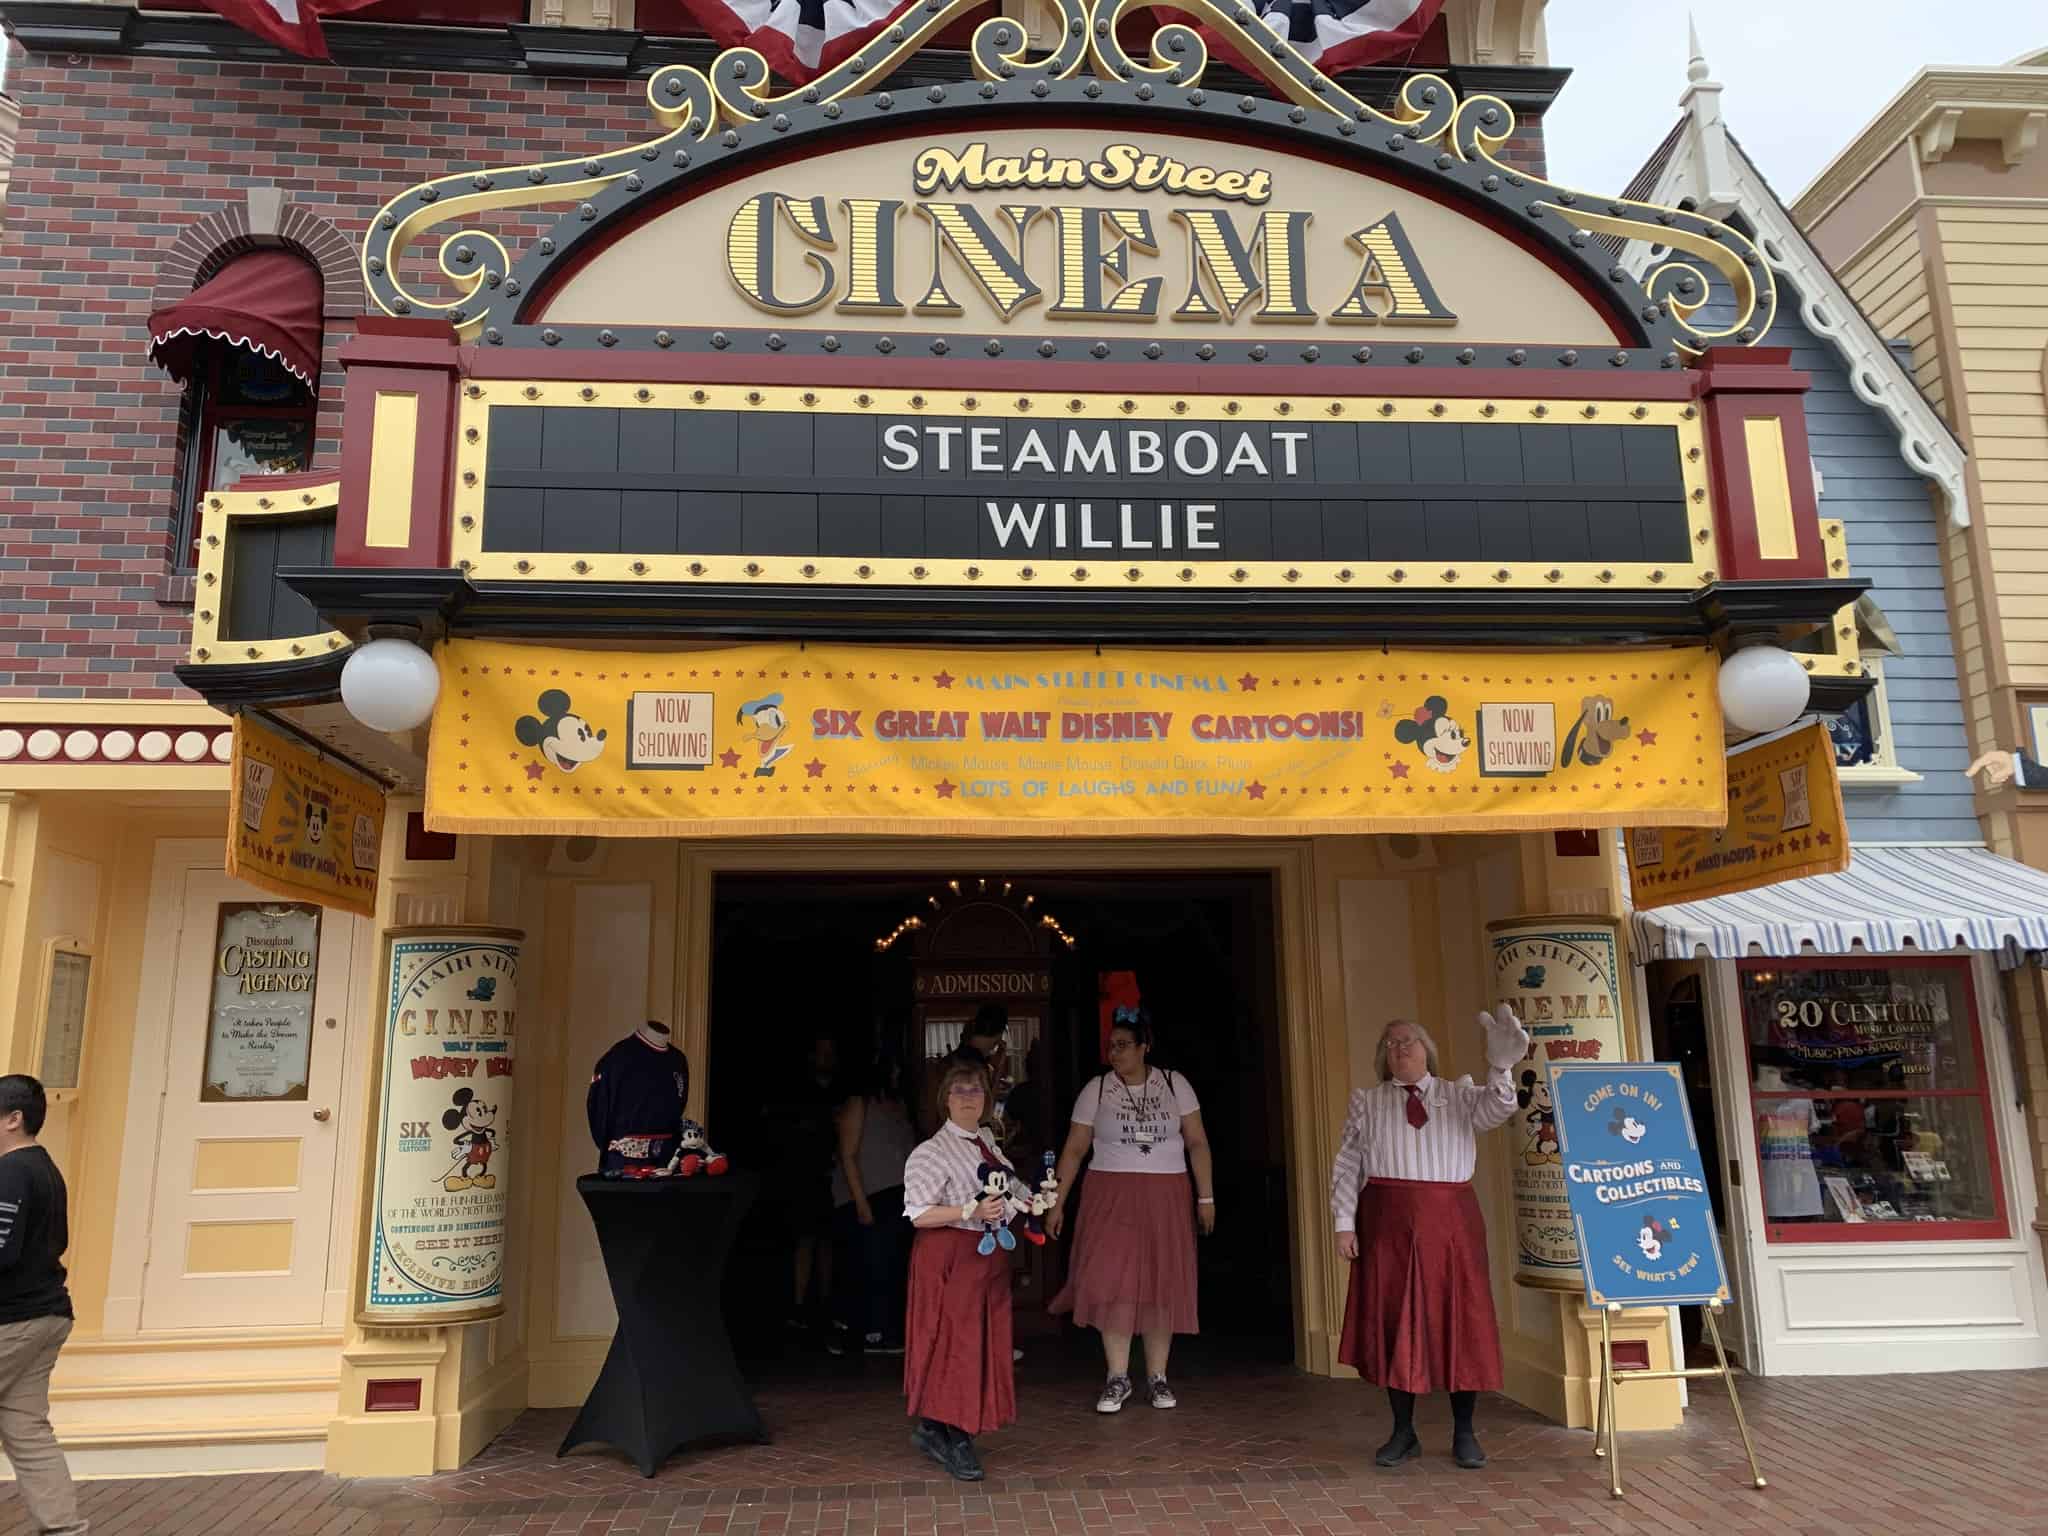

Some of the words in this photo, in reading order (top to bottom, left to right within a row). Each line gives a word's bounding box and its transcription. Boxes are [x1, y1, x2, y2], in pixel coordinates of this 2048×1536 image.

[913, 143, 1086, 192] Main
[1098, 144, 1273, 203] Street
[725, 190, 1460, 325] CINEMA
[882, 424, 1309, 476] STEAMBOAT
[985, 502, 1221, 551] WILLIE
[655, 697, 692, 724] NOW
[1501, 708, 1536, 733] NOW
[811, 707, 865, 741] SIX
[874, 709, 971, 742] GREAT
[980, 710, 1052, 743] WALT
[1060, 711, 1174, 743] DISNEY
[1190, 710, 1365, 744] CARTOONS!
[637, 731, 708, 760] SHOWING
[1488, 741, 1552, 767] SHOWING
[960, 780, 1012, 798] LOTS
[1022, 780, 1049, 798] OF
[1058, 780, 1137, 798] LAUGHS
[1145, 779, 1189, 797] AND
[245, 935, 294, 948] Disneyland
[219, 944, 311, 977] CASTING
[238, 971, 314, 995] AGENCY
[929, 973, 1035, 994] ADMISSION
[1831, 1000, 1936, 1027] CENTURY
[1584, 1083, 1616, 1112] COME
[1619, 1083, 1639, 1098] ON
[399, 1121, 432, 1140] SIX
[1568, 1159, 1655, 1184] CARTOONS
[1659, 1161, 1682, 1171] AND
[1595, 1175, 1704, 1204] COLLECTIBLES
[416, 1239, 450, 1250] SEE
[453, 1237, 471, 1249] IT
[1611, 1254, 1633, 1276] SEE
[1635, 1268, 1677, 1283] WHAT'S
